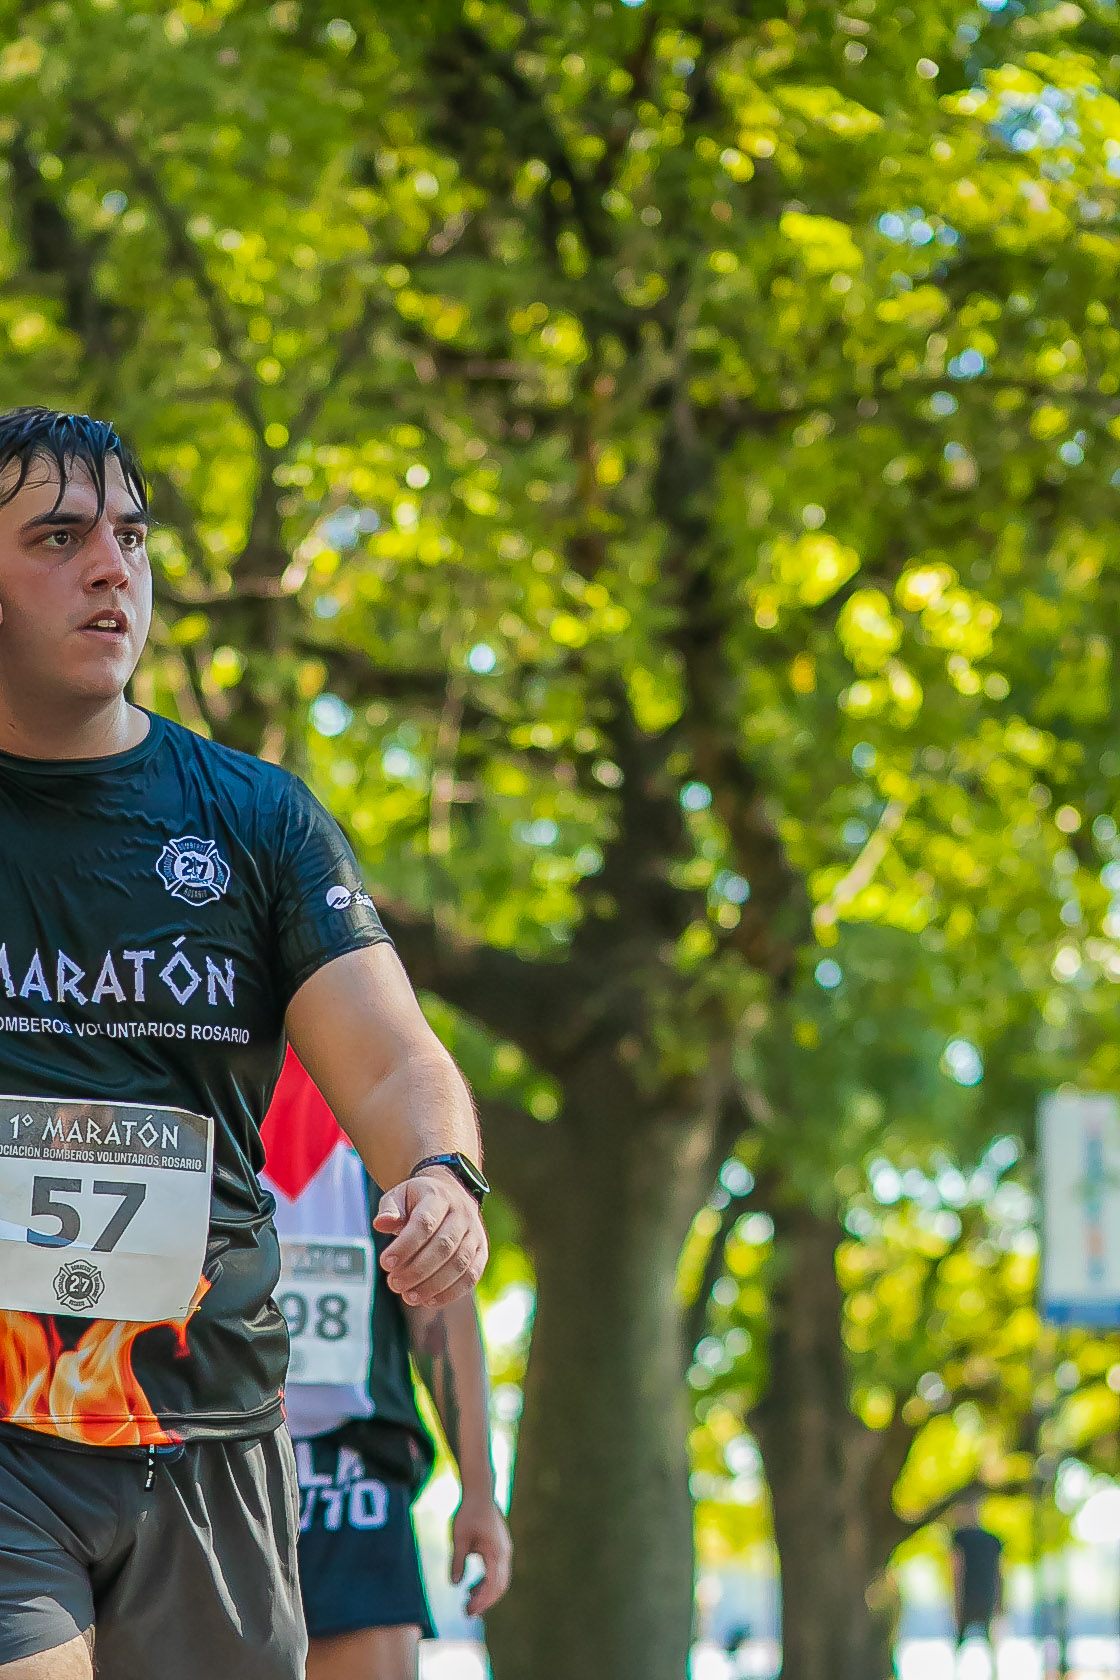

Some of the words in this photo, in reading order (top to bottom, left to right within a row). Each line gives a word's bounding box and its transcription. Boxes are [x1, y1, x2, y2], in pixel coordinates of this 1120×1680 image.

[75, 1023, 186, 1040] VOLUNTARIOS
[191, 1026, 250, 1044] ROSARIO
[41, 1115, 179, 1150] MARATÓN
[42, 1148, 95, 1162] BOMBEROS
[97, 1150, 160, 1166] VOLUNTARIOS
[161, 1156, 202, 1171] ROSARIO
[27, 1176, 147, 1253] 57
[69, 1275, 91, 1292] 27
